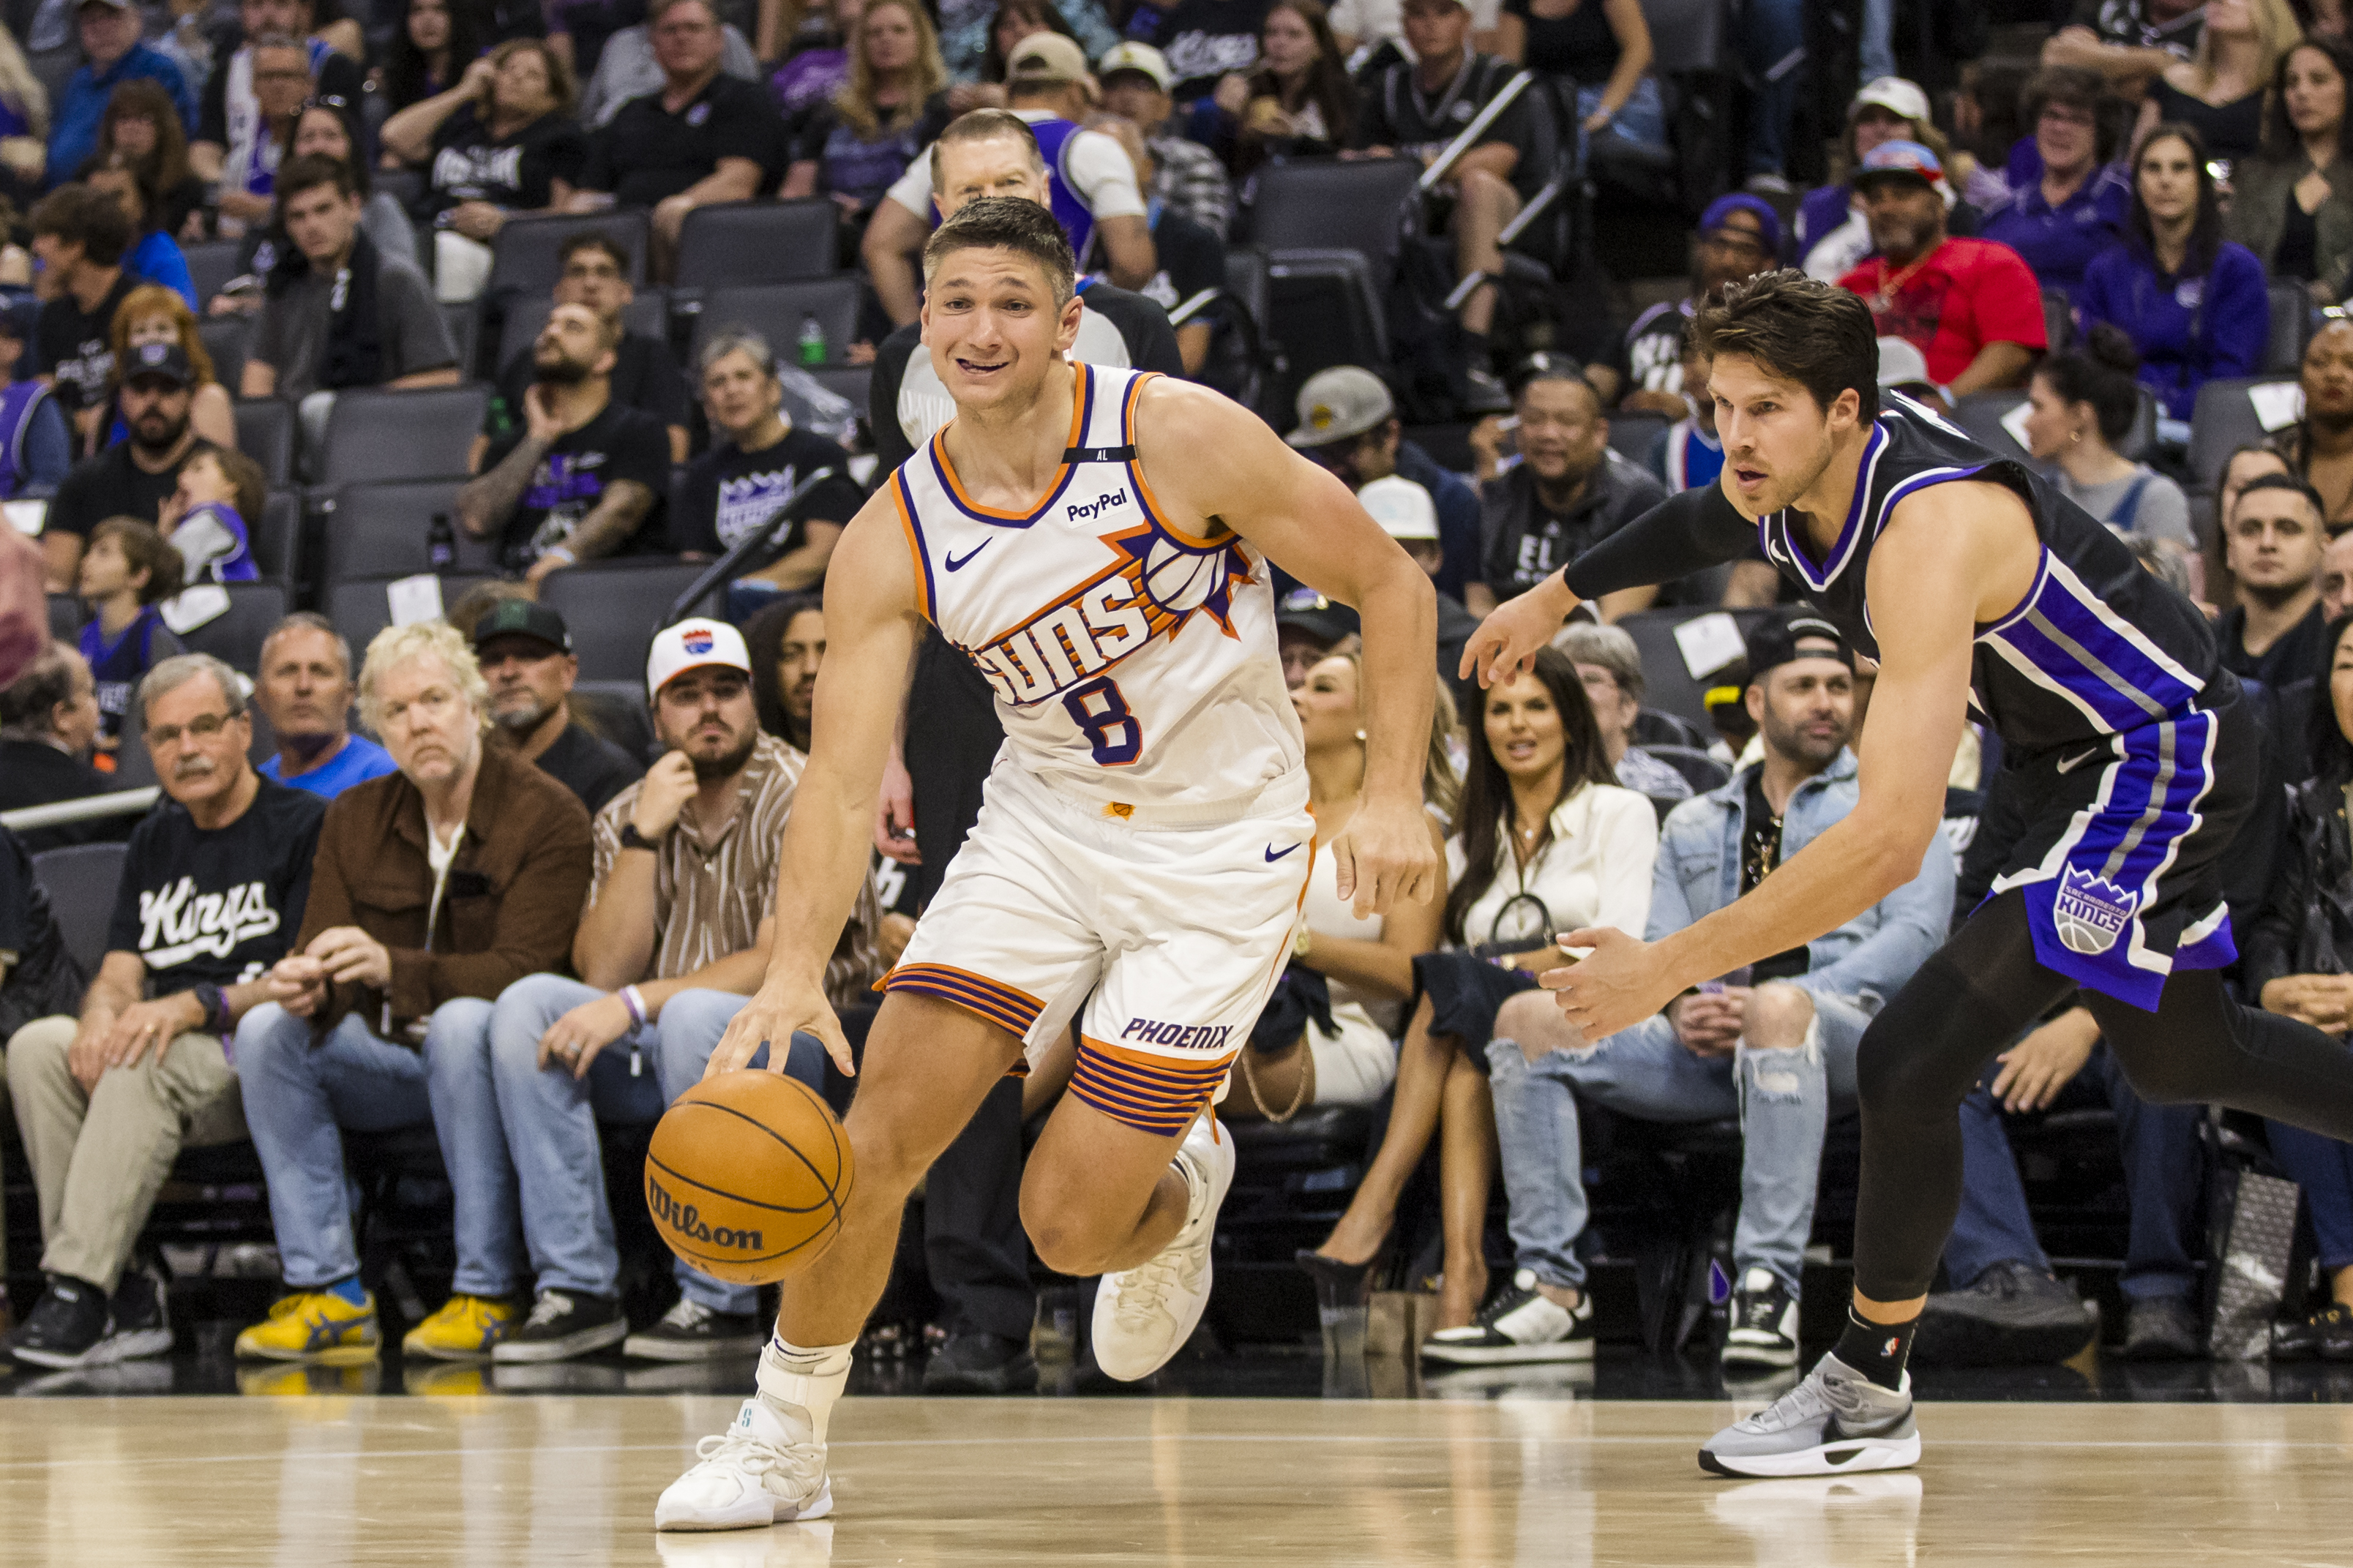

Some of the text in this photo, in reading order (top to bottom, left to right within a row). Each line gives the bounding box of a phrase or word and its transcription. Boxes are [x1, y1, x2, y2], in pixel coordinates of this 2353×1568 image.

[1096, 449, 1108, 462] AL
[1066, 487, 1128, 522] PayPal
[1061, 675, 1143, 768] 8
[138, 875, 281, 969] Kings
[2057, 895, 2123, 934] KINGS
[1121, 1017, 1235, 1049] PHOENIX
[648, 1174, 764, 1251] Wilson
